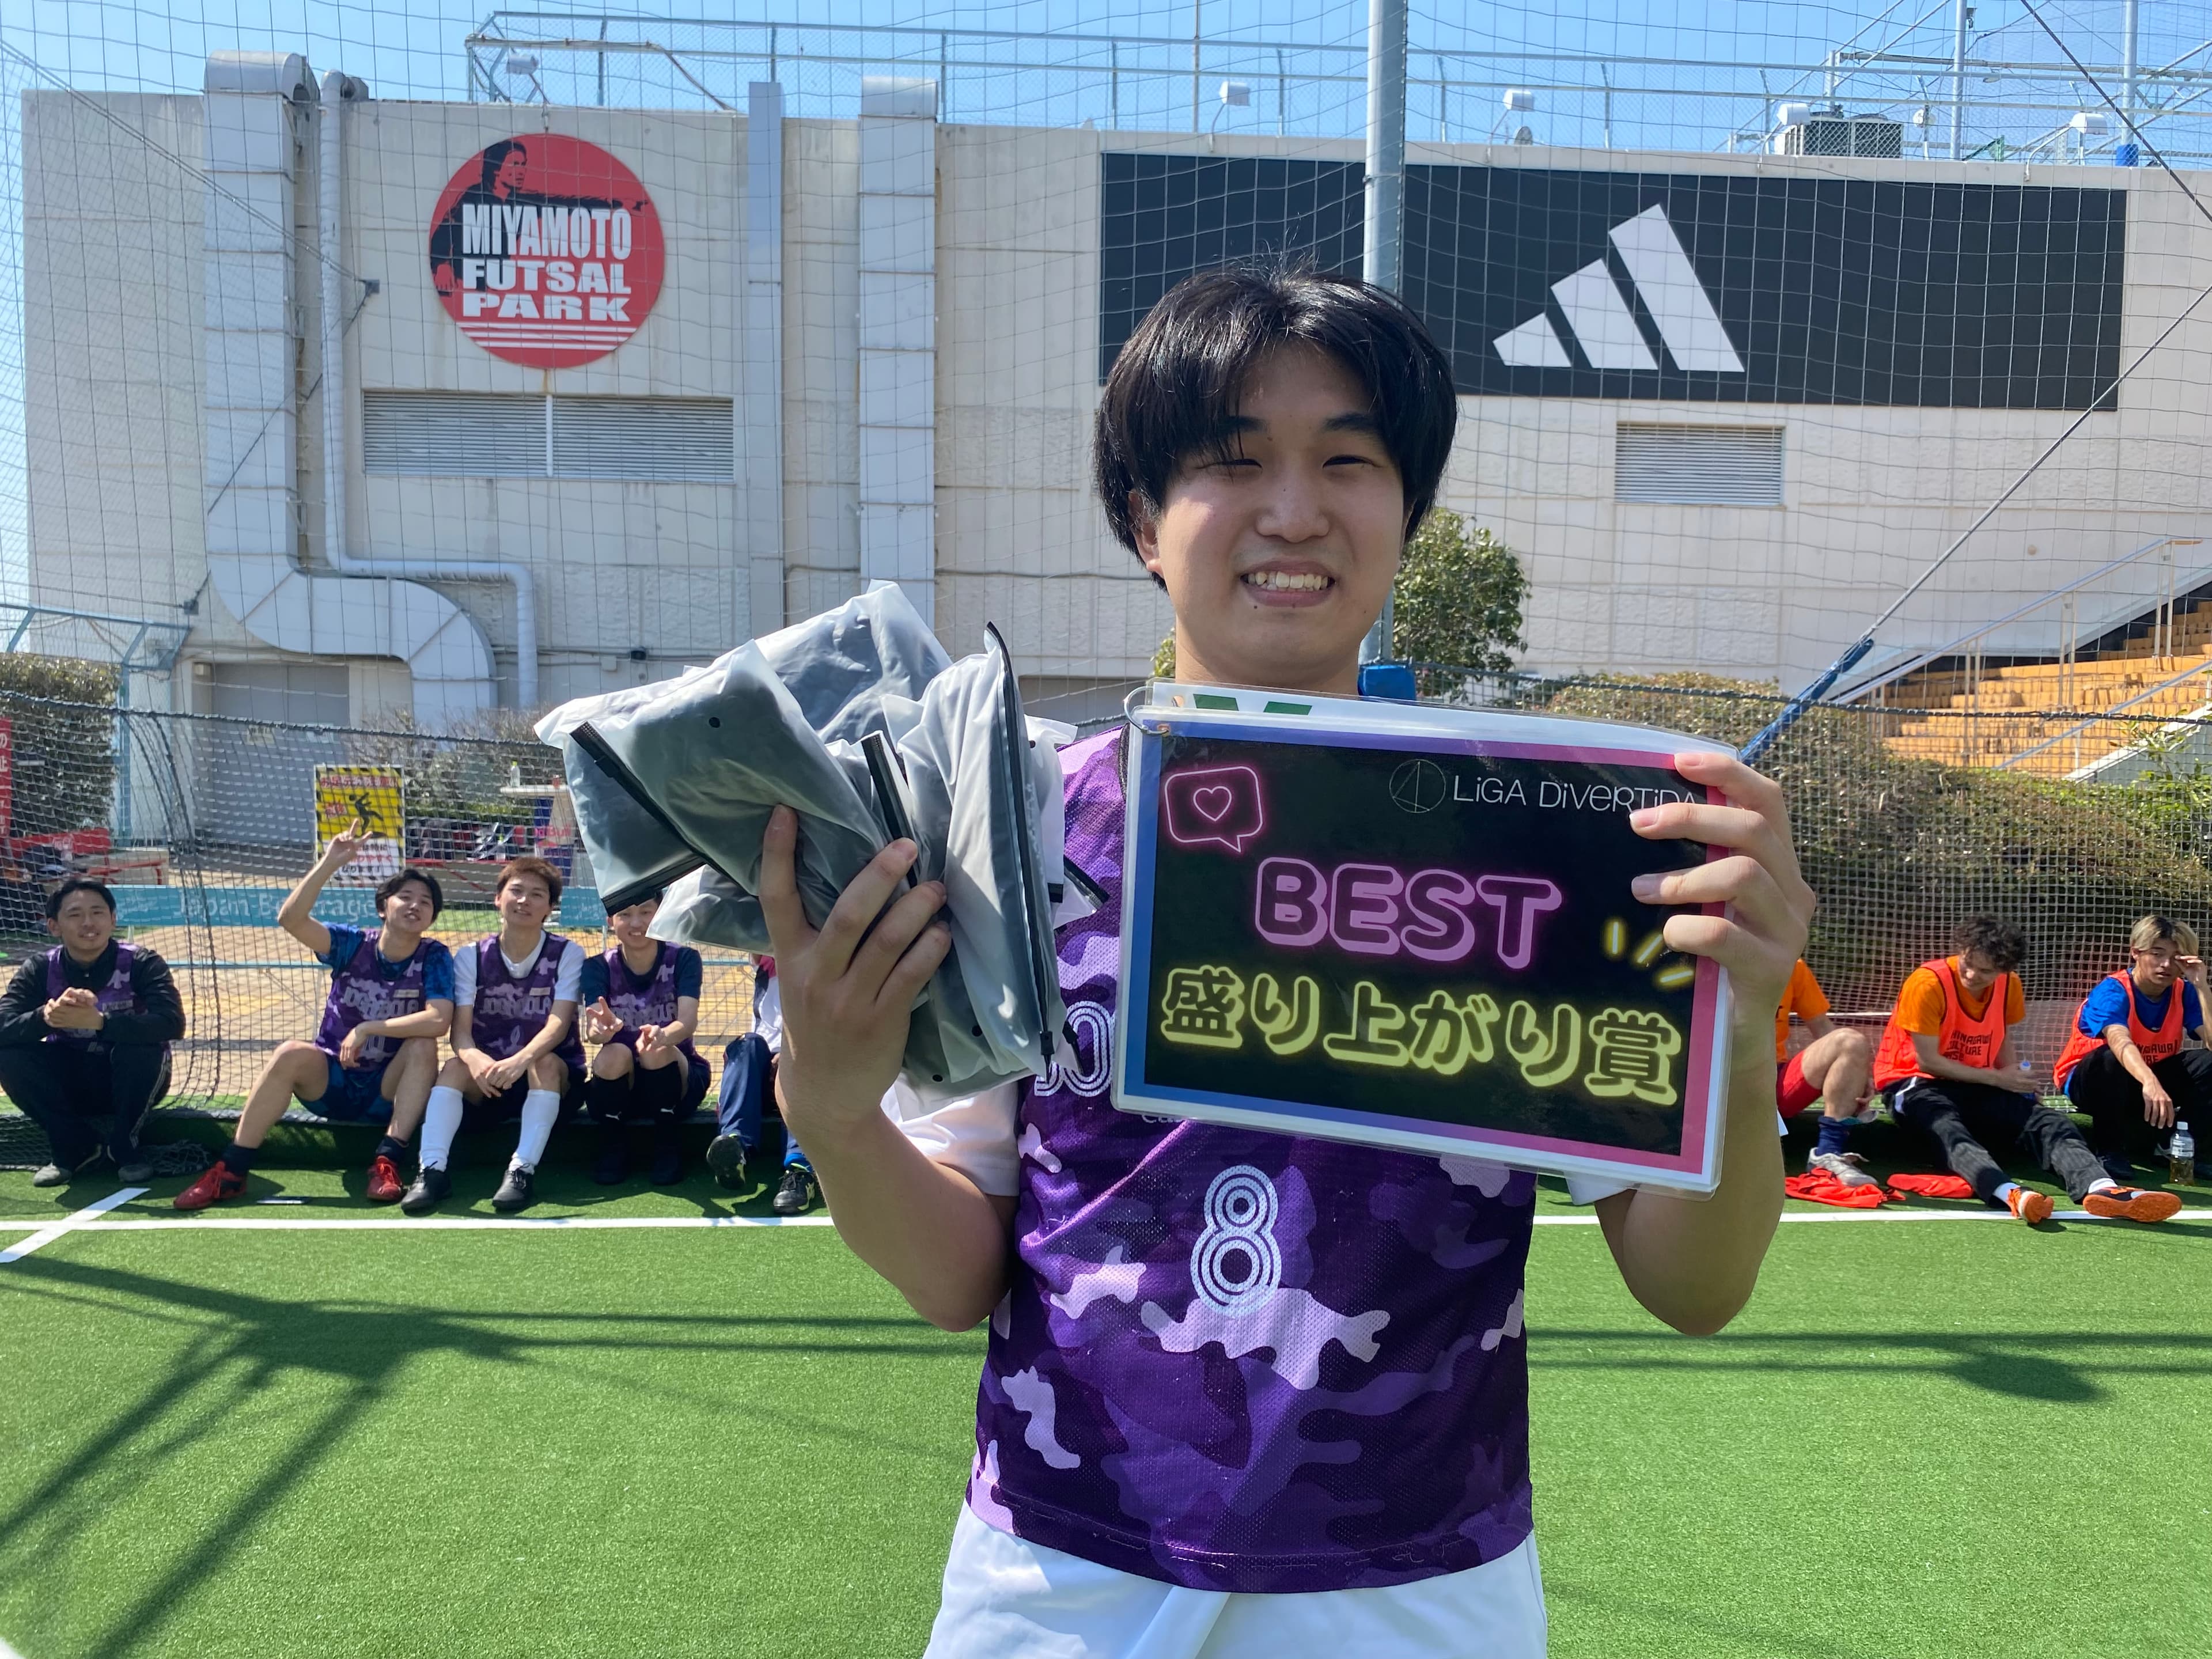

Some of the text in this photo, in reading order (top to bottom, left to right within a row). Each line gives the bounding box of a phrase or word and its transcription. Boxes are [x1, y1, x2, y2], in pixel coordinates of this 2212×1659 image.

[463, 203, 632, 260] MIYAMOTO
[463, 259, 632, 294] FUTSAL
[463, 292, 631, 322] PARK
[1253, 856, 1563, 969] BEST
[1160, 964, 1682, 1106] 盛り上がり賞
[1191, 1165, 1281, 1318] 8
